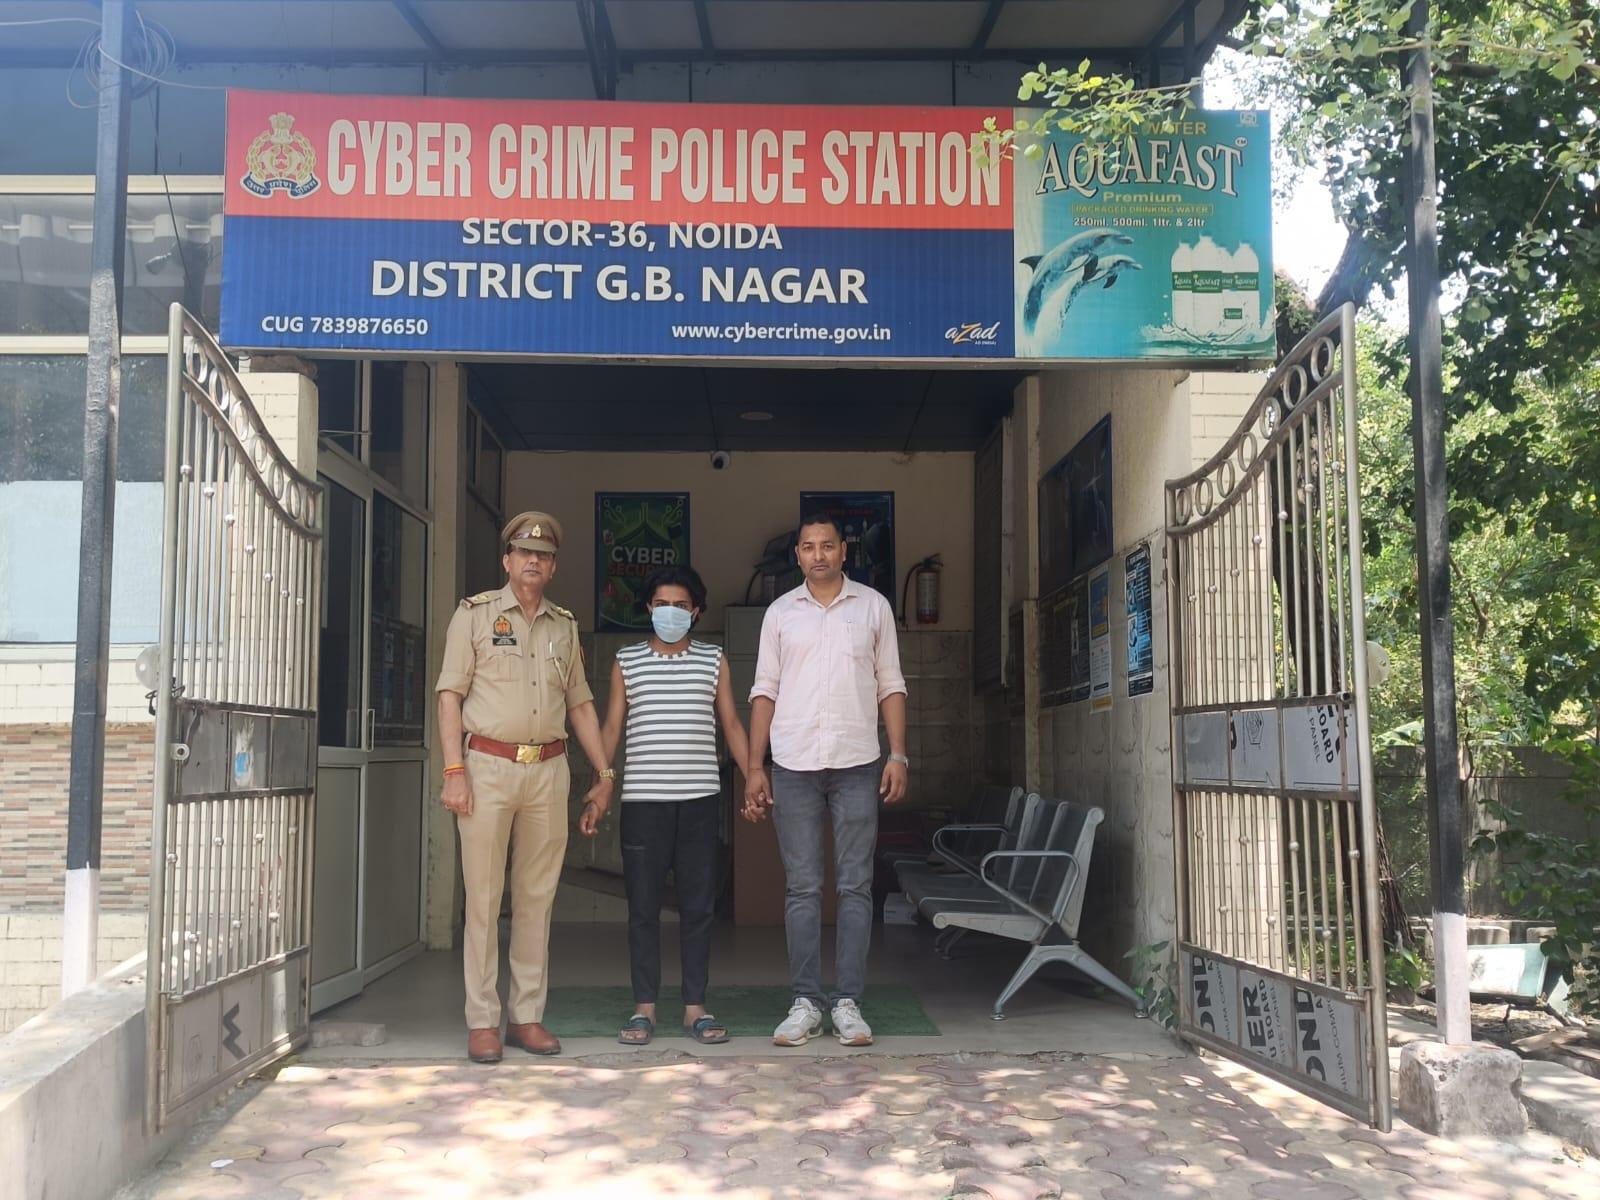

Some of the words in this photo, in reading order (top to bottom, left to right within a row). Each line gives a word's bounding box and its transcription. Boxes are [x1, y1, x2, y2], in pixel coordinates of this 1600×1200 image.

[327, 119, 472, 198] CYBER
[488, 123, 635, 201] CRIME
[650, 127, 807, 205] POLICE
[821, 130, 1001, 206] STATION
[1035, 137, 1244, 198] AQUAFAST
[1103, 191, 1182, 203] Premium
[462, 217, 656, 252] SECTOR-36,
[668, 222, 784, 251] NOIDA
[1175, 217, 1183, 227] &
[372, 260, 583, 300] DISTRICT
[596, 264, 685, 302] G.B.
[701, 266, 869, 305] NAGAR
[261, 316, 304, 334] CUG
[310, 316, 429, 336] 7839876650
[671, 322, 891, 344] www.cybercrime.gov.in
[611, 546, 676, 565] CYBER
[1258, 978, 1277, 1041] BOARD
